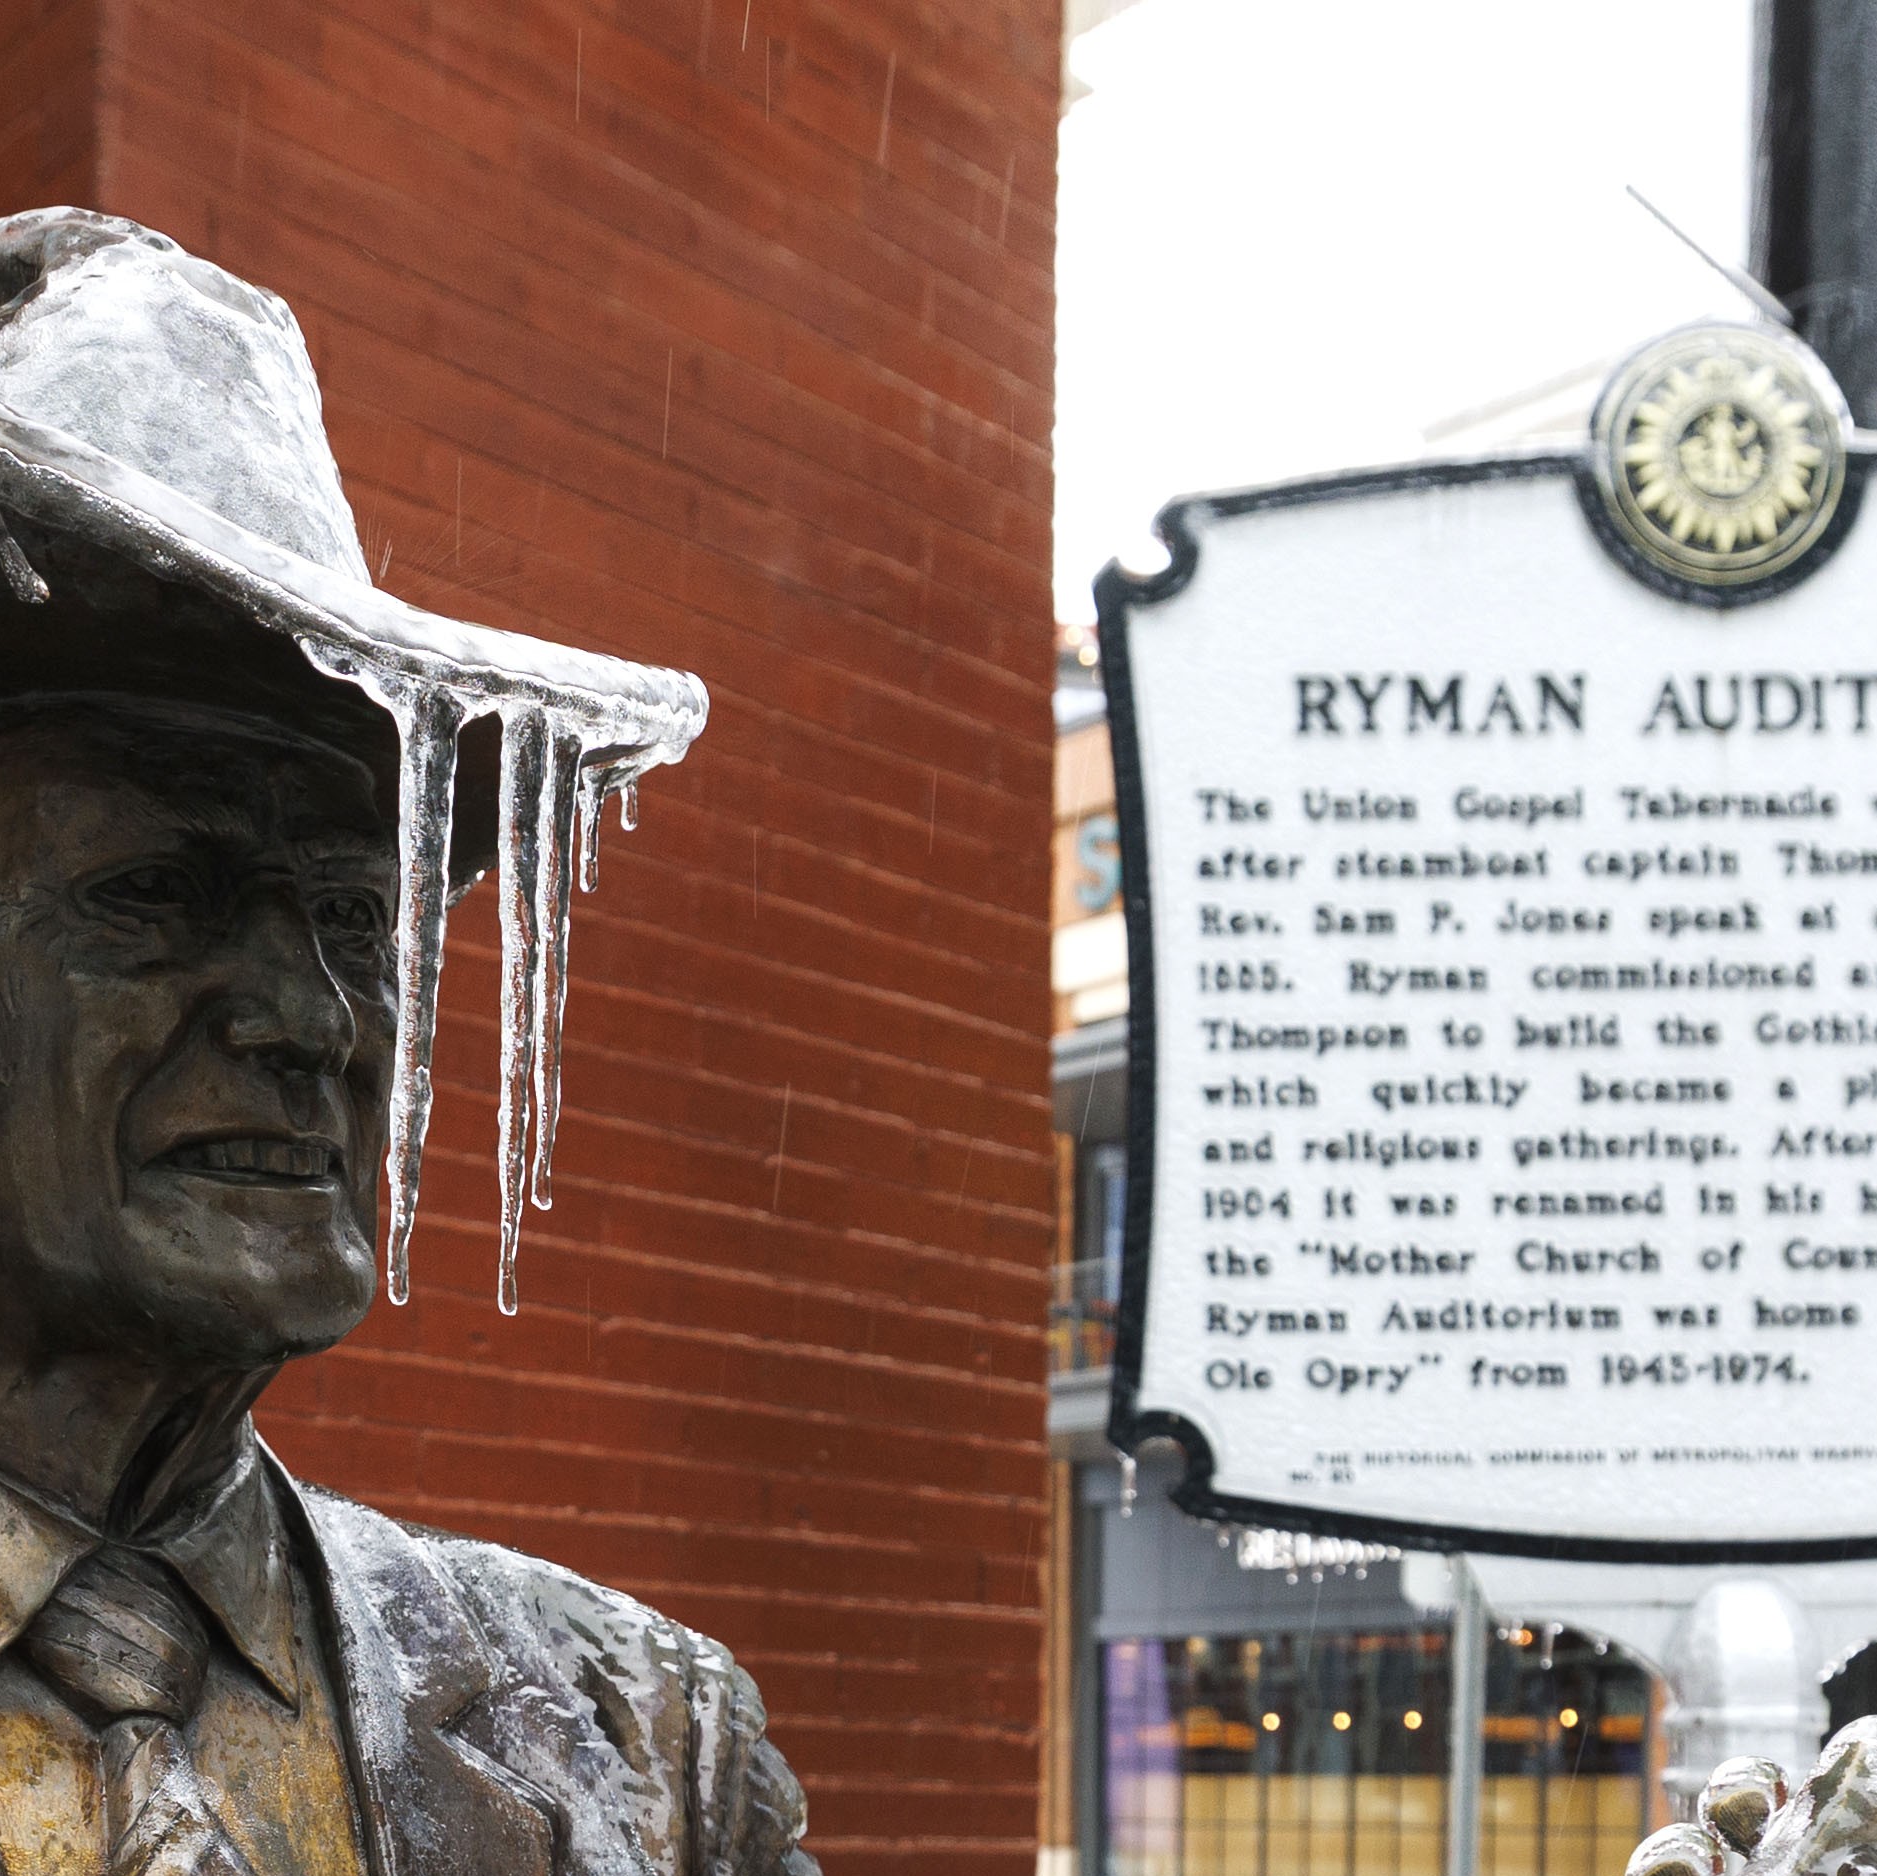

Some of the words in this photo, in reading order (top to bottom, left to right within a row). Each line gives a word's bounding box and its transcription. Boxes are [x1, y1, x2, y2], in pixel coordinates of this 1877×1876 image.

[1294, 673, 1585, 736] RYMAN
[1196, 790, 1271, 824] The
[1302, 790, 1417, 823] Union
[1453, 788, 1583, 828] Gospel
[1619, 787, 1837, 821] Tabernacle
[1197, 849, 1303, 881] after
[1335, 845, 1548, 879] steamboat
[1582, 845, 1738, 883] captain
[1200, 905, 1282, 936] Rev.
[1314, 904, 1395, 936] Sam
[1430, 902, 1464, 933] P.
[1497, 901, 1610, 935] Jones
[1647, 900, 1762, 939] speak
[1798, 903, 1836, 932] at
[1348, 961, 1487, 997] Ryman
[1530, 957, 1815, 992] commissioned
[1200, 1019, 1408, 1057] Thompson
[1440, 1019, 1483, 1050] to
[1515, 1015, 1620, 1050] build
[1654, 1015, 1721, 1047] the
[1201, 1077, 1318, 1108] which
[1370, 1074, 1528, 1113] quickly
[1579, 1073, 1731, 1105] became
[1775, 1079, 1796, 1102] a
[1202, 1133, 1274, 1164] and
[1302, 1131, 1480, 1169] religious
[1511, 1129, 1738, 1169] gatherings.
[1769, 1128, 1877, 1158] After
[1204, 1188, 1291, 1221] 1904
[1324, 1189, 1354, 1219] it
[1390, 1195, 1456, 1218] was
[1492, 1184, 1664, 1217] renamed
[1699, 1185, 1736, 1215] in
[1764, 1184, 1822, 1215] his
[1203, 1246, 1271, 1278] the
[1514, 1241, 1660, 1275] Church
[1699, 1240, 1744, 1273] of
[1205, 1304, 1347, 1338] Ryman
[1381, 1300, 1621, 1332] Auditorium
[1652, 1306, 1719, 1330] was
[1752, 1297, 1860, 1329] home
[1204, 1360, 1272, 1392] Ole
[1470, 1358, 1567, 1389] from
